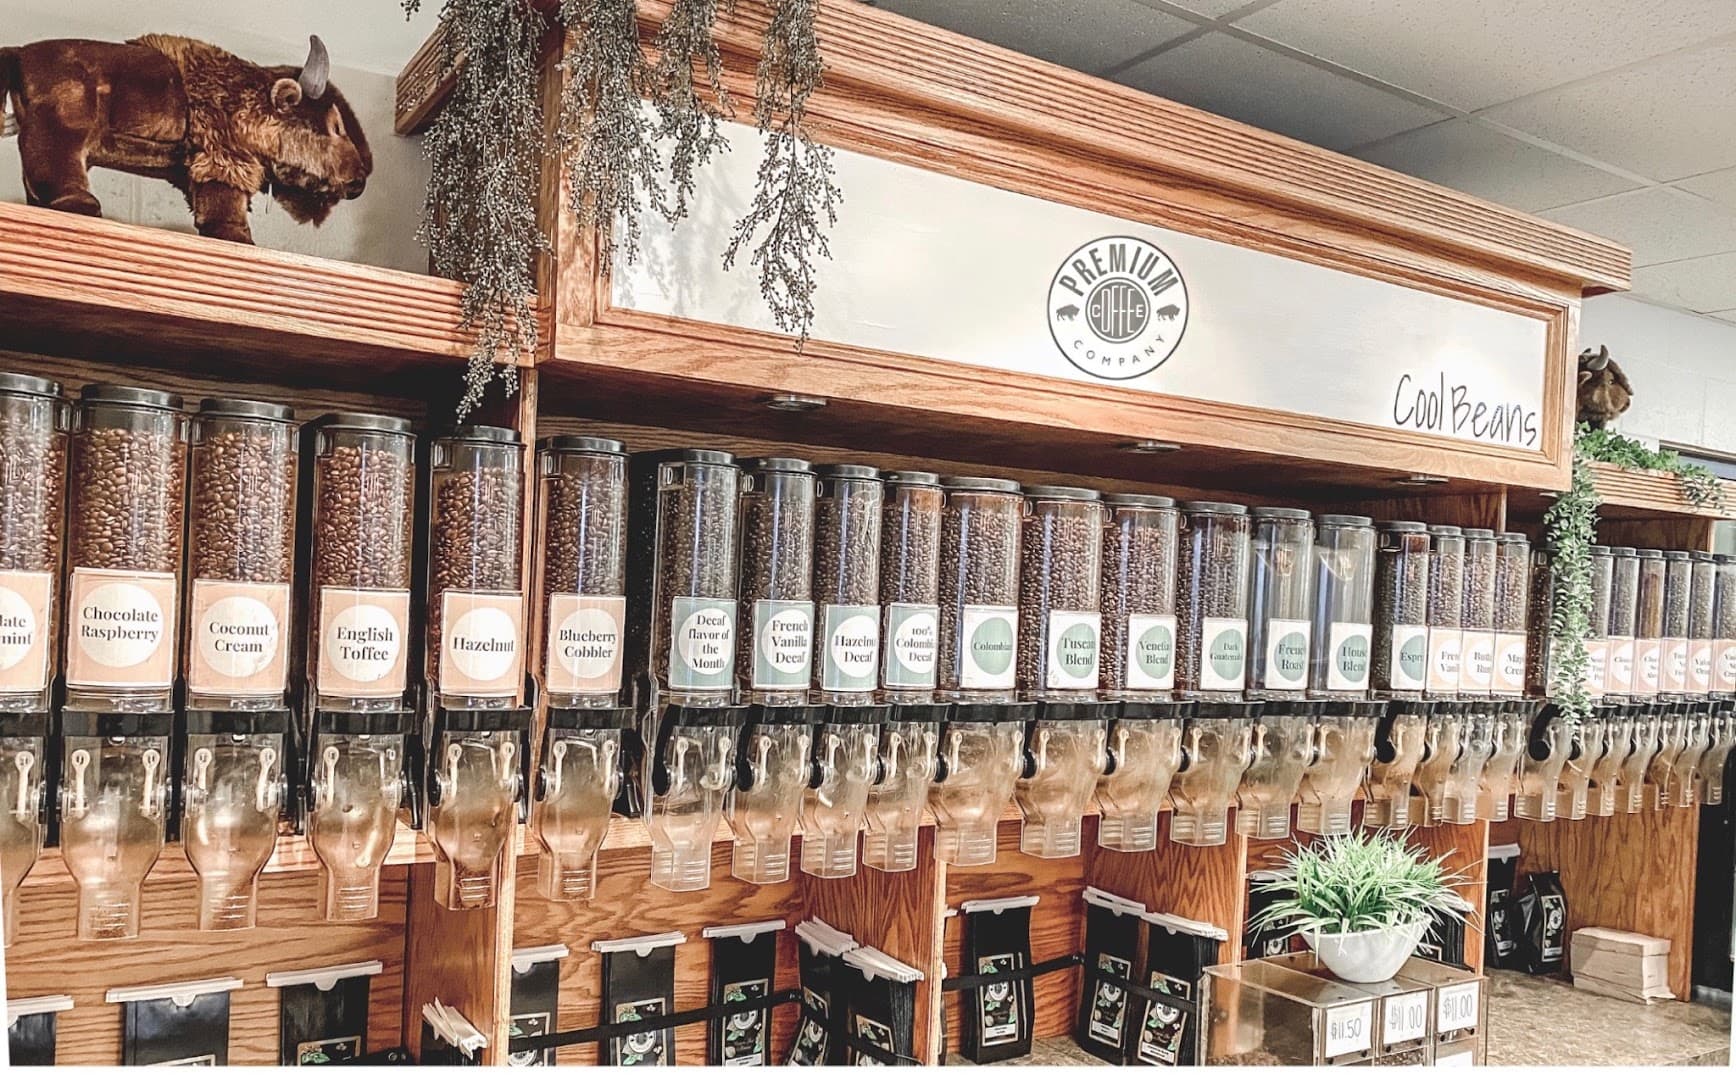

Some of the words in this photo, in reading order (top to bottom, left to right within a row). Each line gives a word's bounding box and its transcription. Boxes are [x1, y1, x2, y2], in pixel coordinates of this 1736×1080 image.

[1058, 243, 1179, 297] PREMIUM
[1092, 286, 1145, 337] COFFEE
[1074, 335, 1165, 367] COMPANY
[1393, 371, 1444, 431] Cool
[1451, 385, 1537, 447] Beans
[82, 606, 159, 623] Chocolate
[696, 614, 727, 626] Decaf
[209, 621, 269, 637] Coconut
[772, 619, 808, 632] French
[80, 625, 160, 643] Raspberry
[336, 626, 394, 643] English
[559, 628, 617, 645] Blueberry
[688, 628, 719, 640] flavor
[721, 629, 730, 640] of
[214, 639, 263, 654] Cream
[453, 636, 515, 653] Hazelnut
[564, 645, 614, 659] Cobbler
[702, 643, 719, 655] the
[339, 645, 390, 662] Toffee
[775, 651, 806, 664] Decaf
[844, 651, 873, 663] Decaf
[908, 651, 933, 662] Decaf
[1065, 653, 1093, 665] Blend
[692, 657, 725, 669] Month
[1388, 1004, 1422, 1030] $1100
